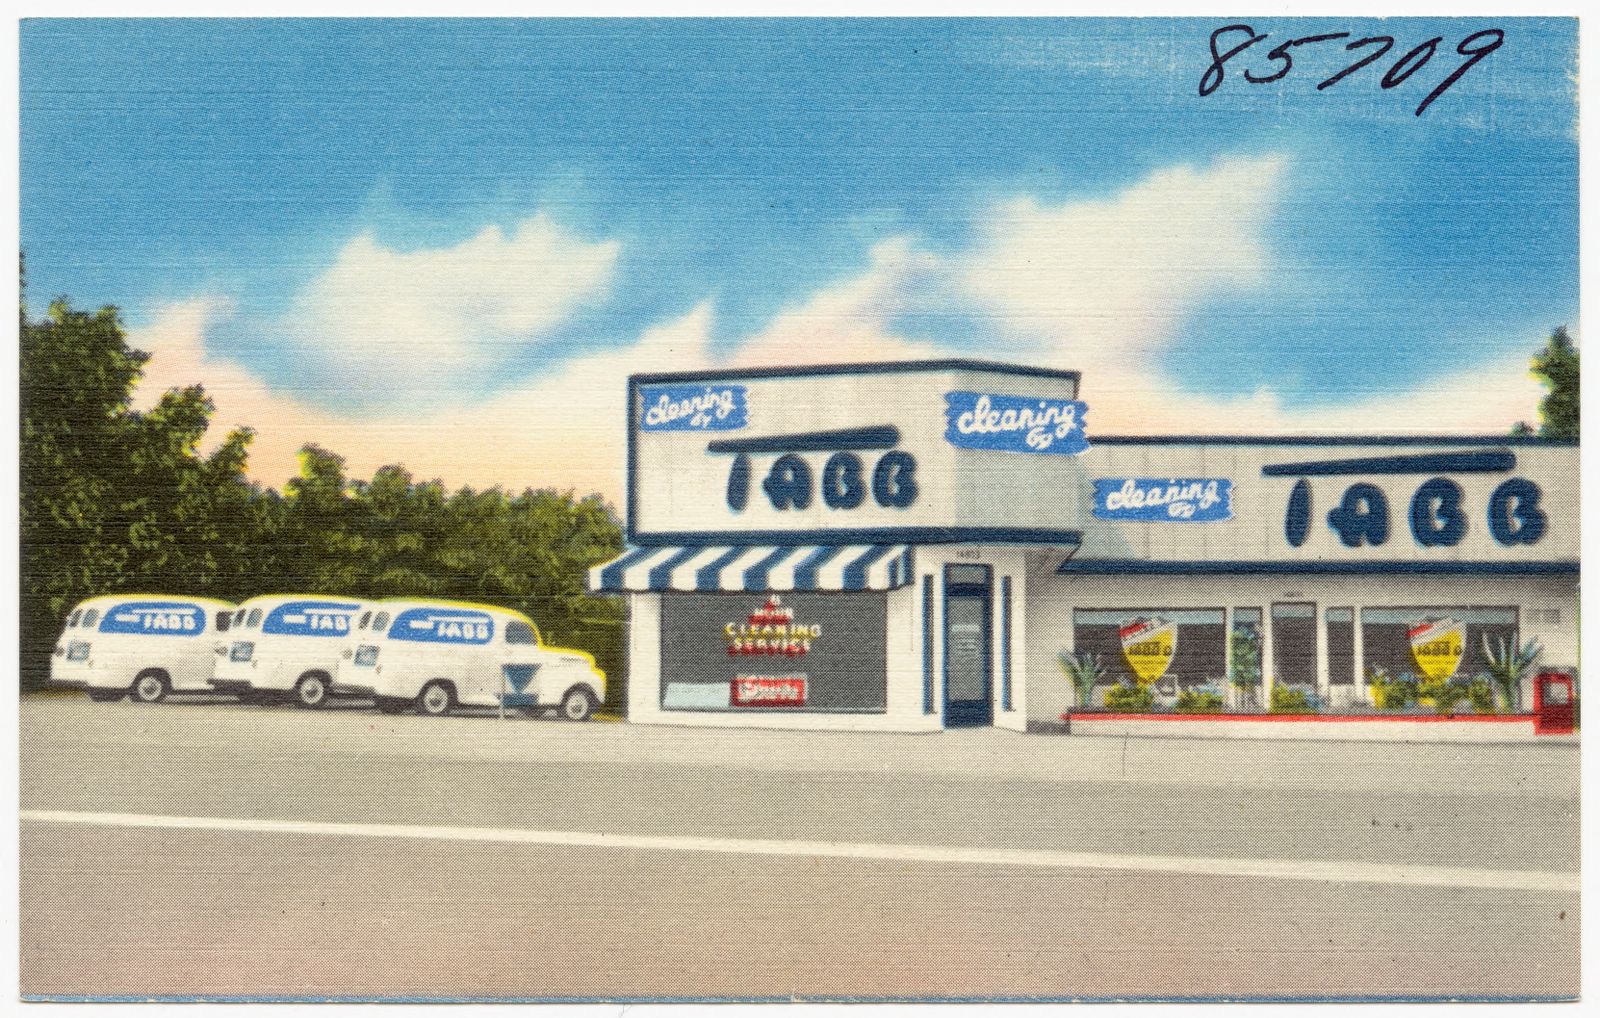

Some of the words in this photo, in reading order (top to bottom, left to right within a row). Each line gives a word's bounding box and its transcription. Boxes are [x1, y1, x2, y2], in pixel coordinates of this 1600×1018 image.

[1198, 24, 1505, 117] 85709
[704, 423, 920, 514] TABB
[1260, 446, 1549, 548] TABB
